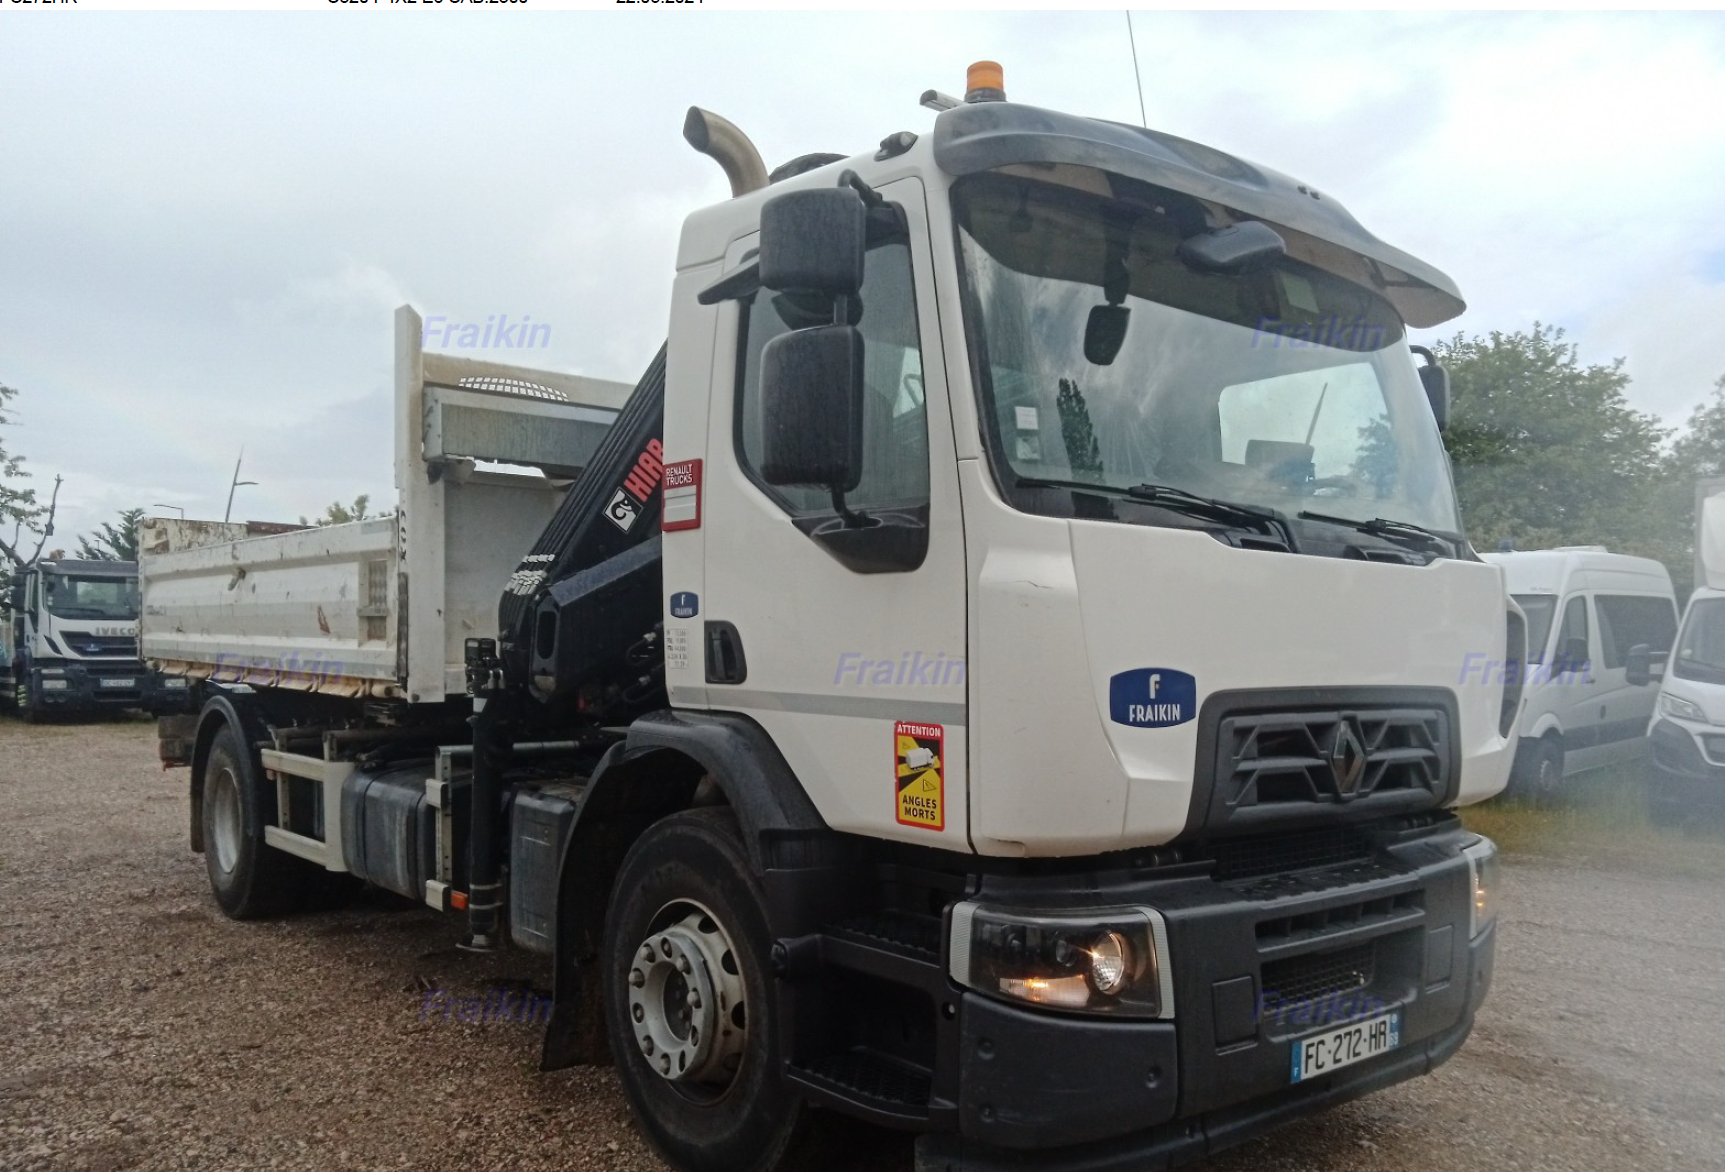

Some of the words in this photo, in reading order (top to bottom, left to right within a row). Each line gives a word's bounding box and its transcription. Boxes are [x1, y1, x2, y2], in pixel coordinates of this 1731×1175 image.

[666, 464, 693, 477] RENAULT
[666, 474, 693, 486] TRUCKS
[95, 626, 136, 636] IVECO
[1129, 703, 1180, 722] FRAIKIN
[897, 724, 941, 737] ATTENTION
[902, 794, 937, 809] ANGLES
[904, 806, 936, 821] MORTS
[1304, 1019, 1388, 1075] FC-272-HR
